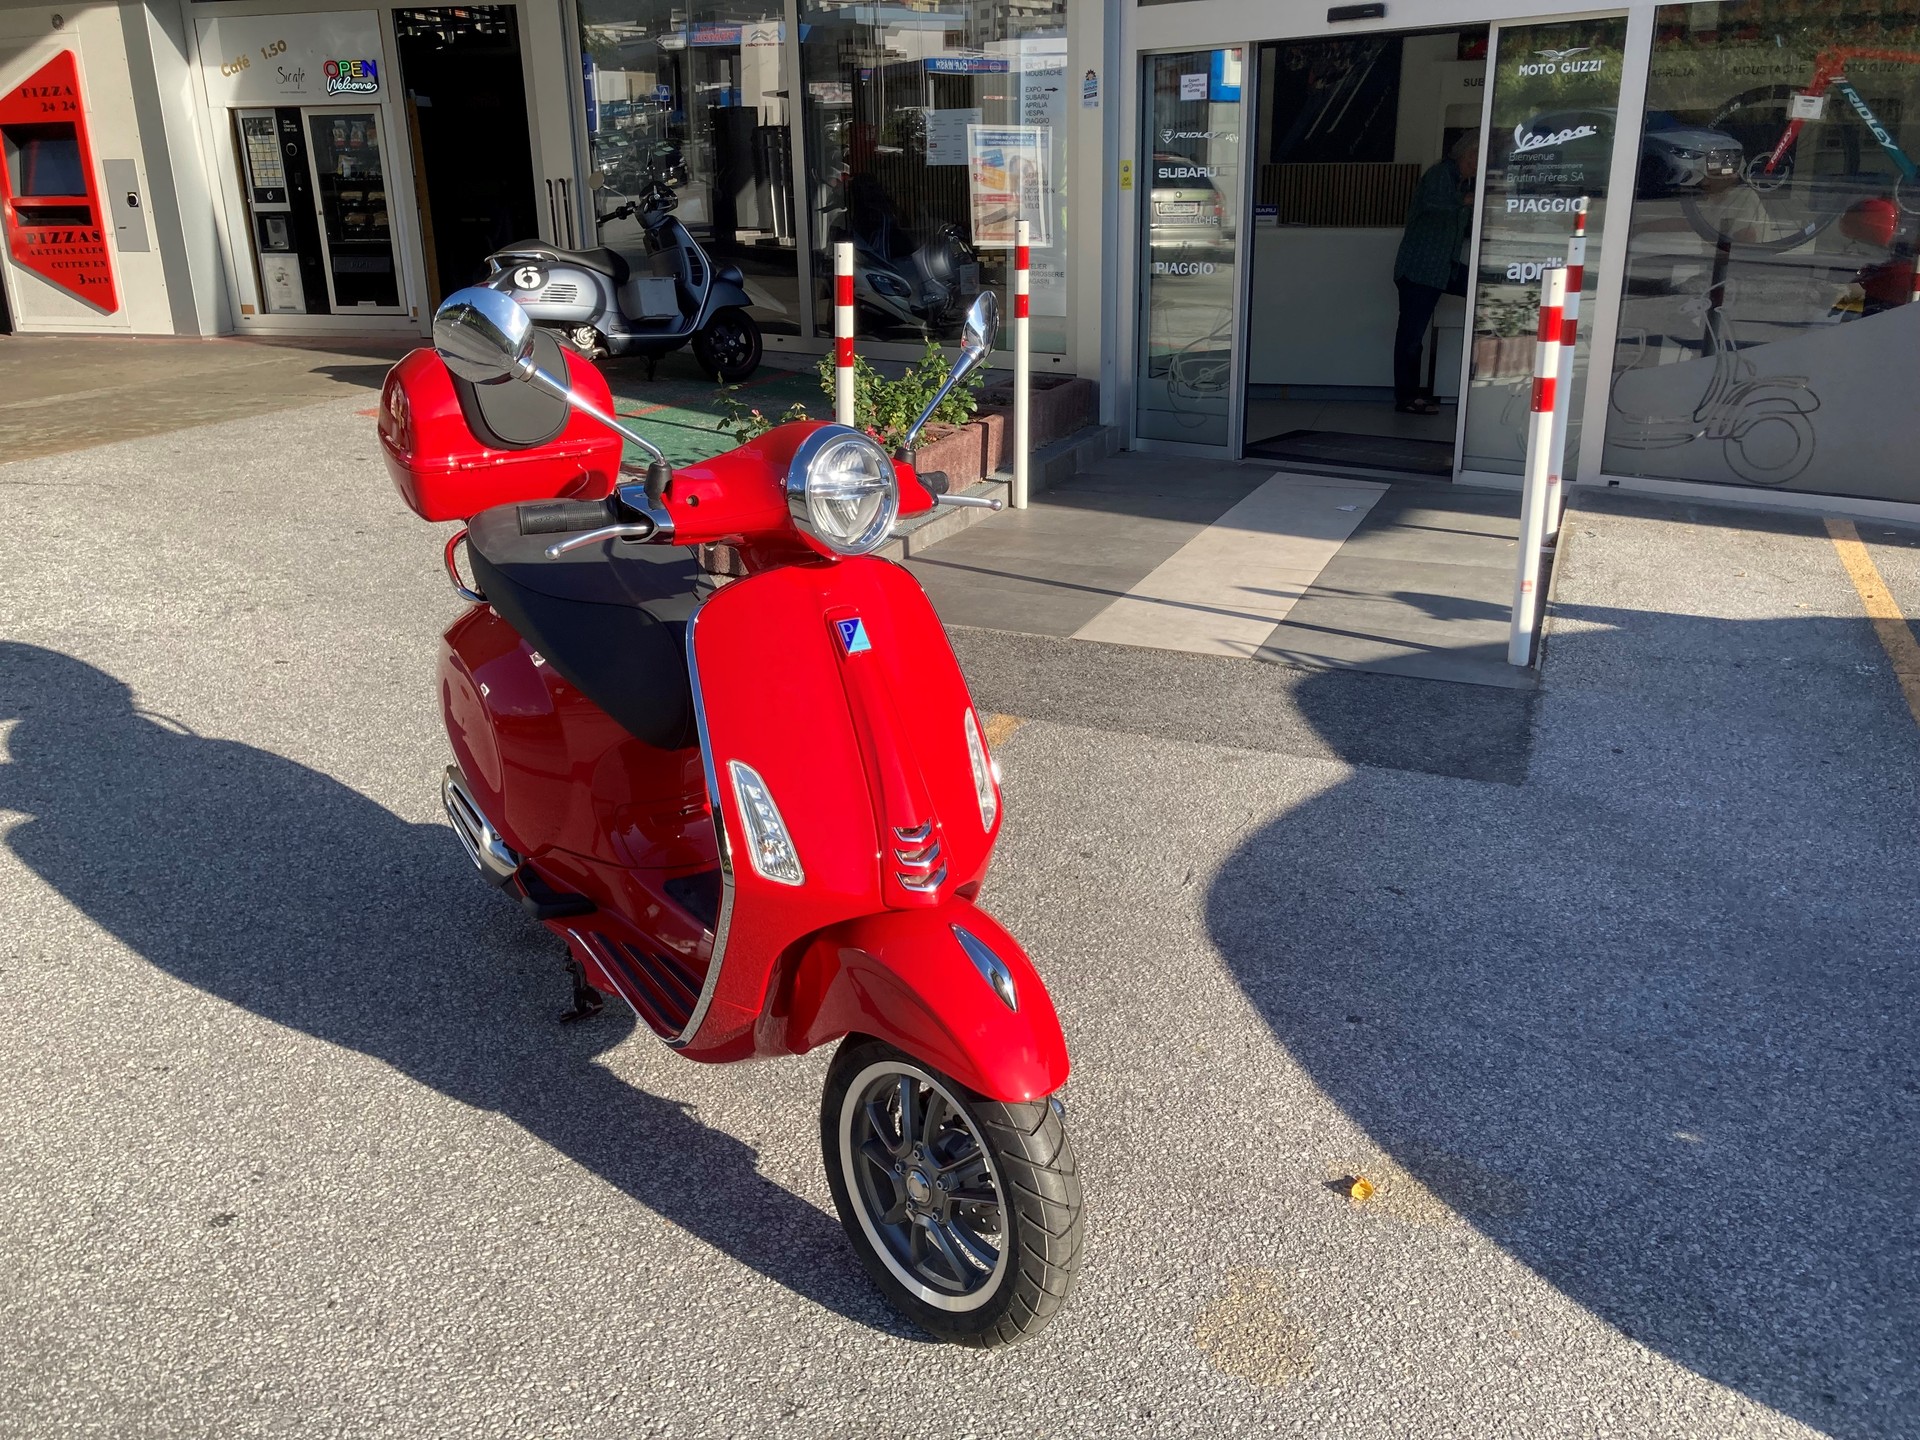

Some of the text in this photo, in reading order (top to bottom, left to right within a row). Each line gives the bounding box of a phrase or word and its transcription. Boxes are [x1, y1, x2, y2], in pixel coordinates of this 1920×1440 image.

[261, 40, 287, 60] 1.50
[221, 54, 250, 77] Café
[323, 60, 378, 78] OPEN
[1518, 60, 1602, 76] MOTO GUZZI
[22, 86, 72, 98] PIZZA
[327, 76, 378, 96] Welcome
[1842, 88, 1899, 150] RIDLEY
[1514, 124, 1598, 153] Vespa
[1509, 152, 1555, 161] Bienvenue
[1158, 167, 1217, 178] SUBARU
[1540, 172, 1568, 182] Frères
[1570, 172, 1584, 181] SA
[1506, 199, 1583, 212] PIAGGIO
[26, 230, 101, 244] PIZZAS
[30, 247, 104, 256] ARTISANALES
[51, 261, 90, 269] CUITES
[1155, 262, 1214, 275] PIAGGIO
[514, 266, 540, 288] 6
[840, 622, 854, 642] P
